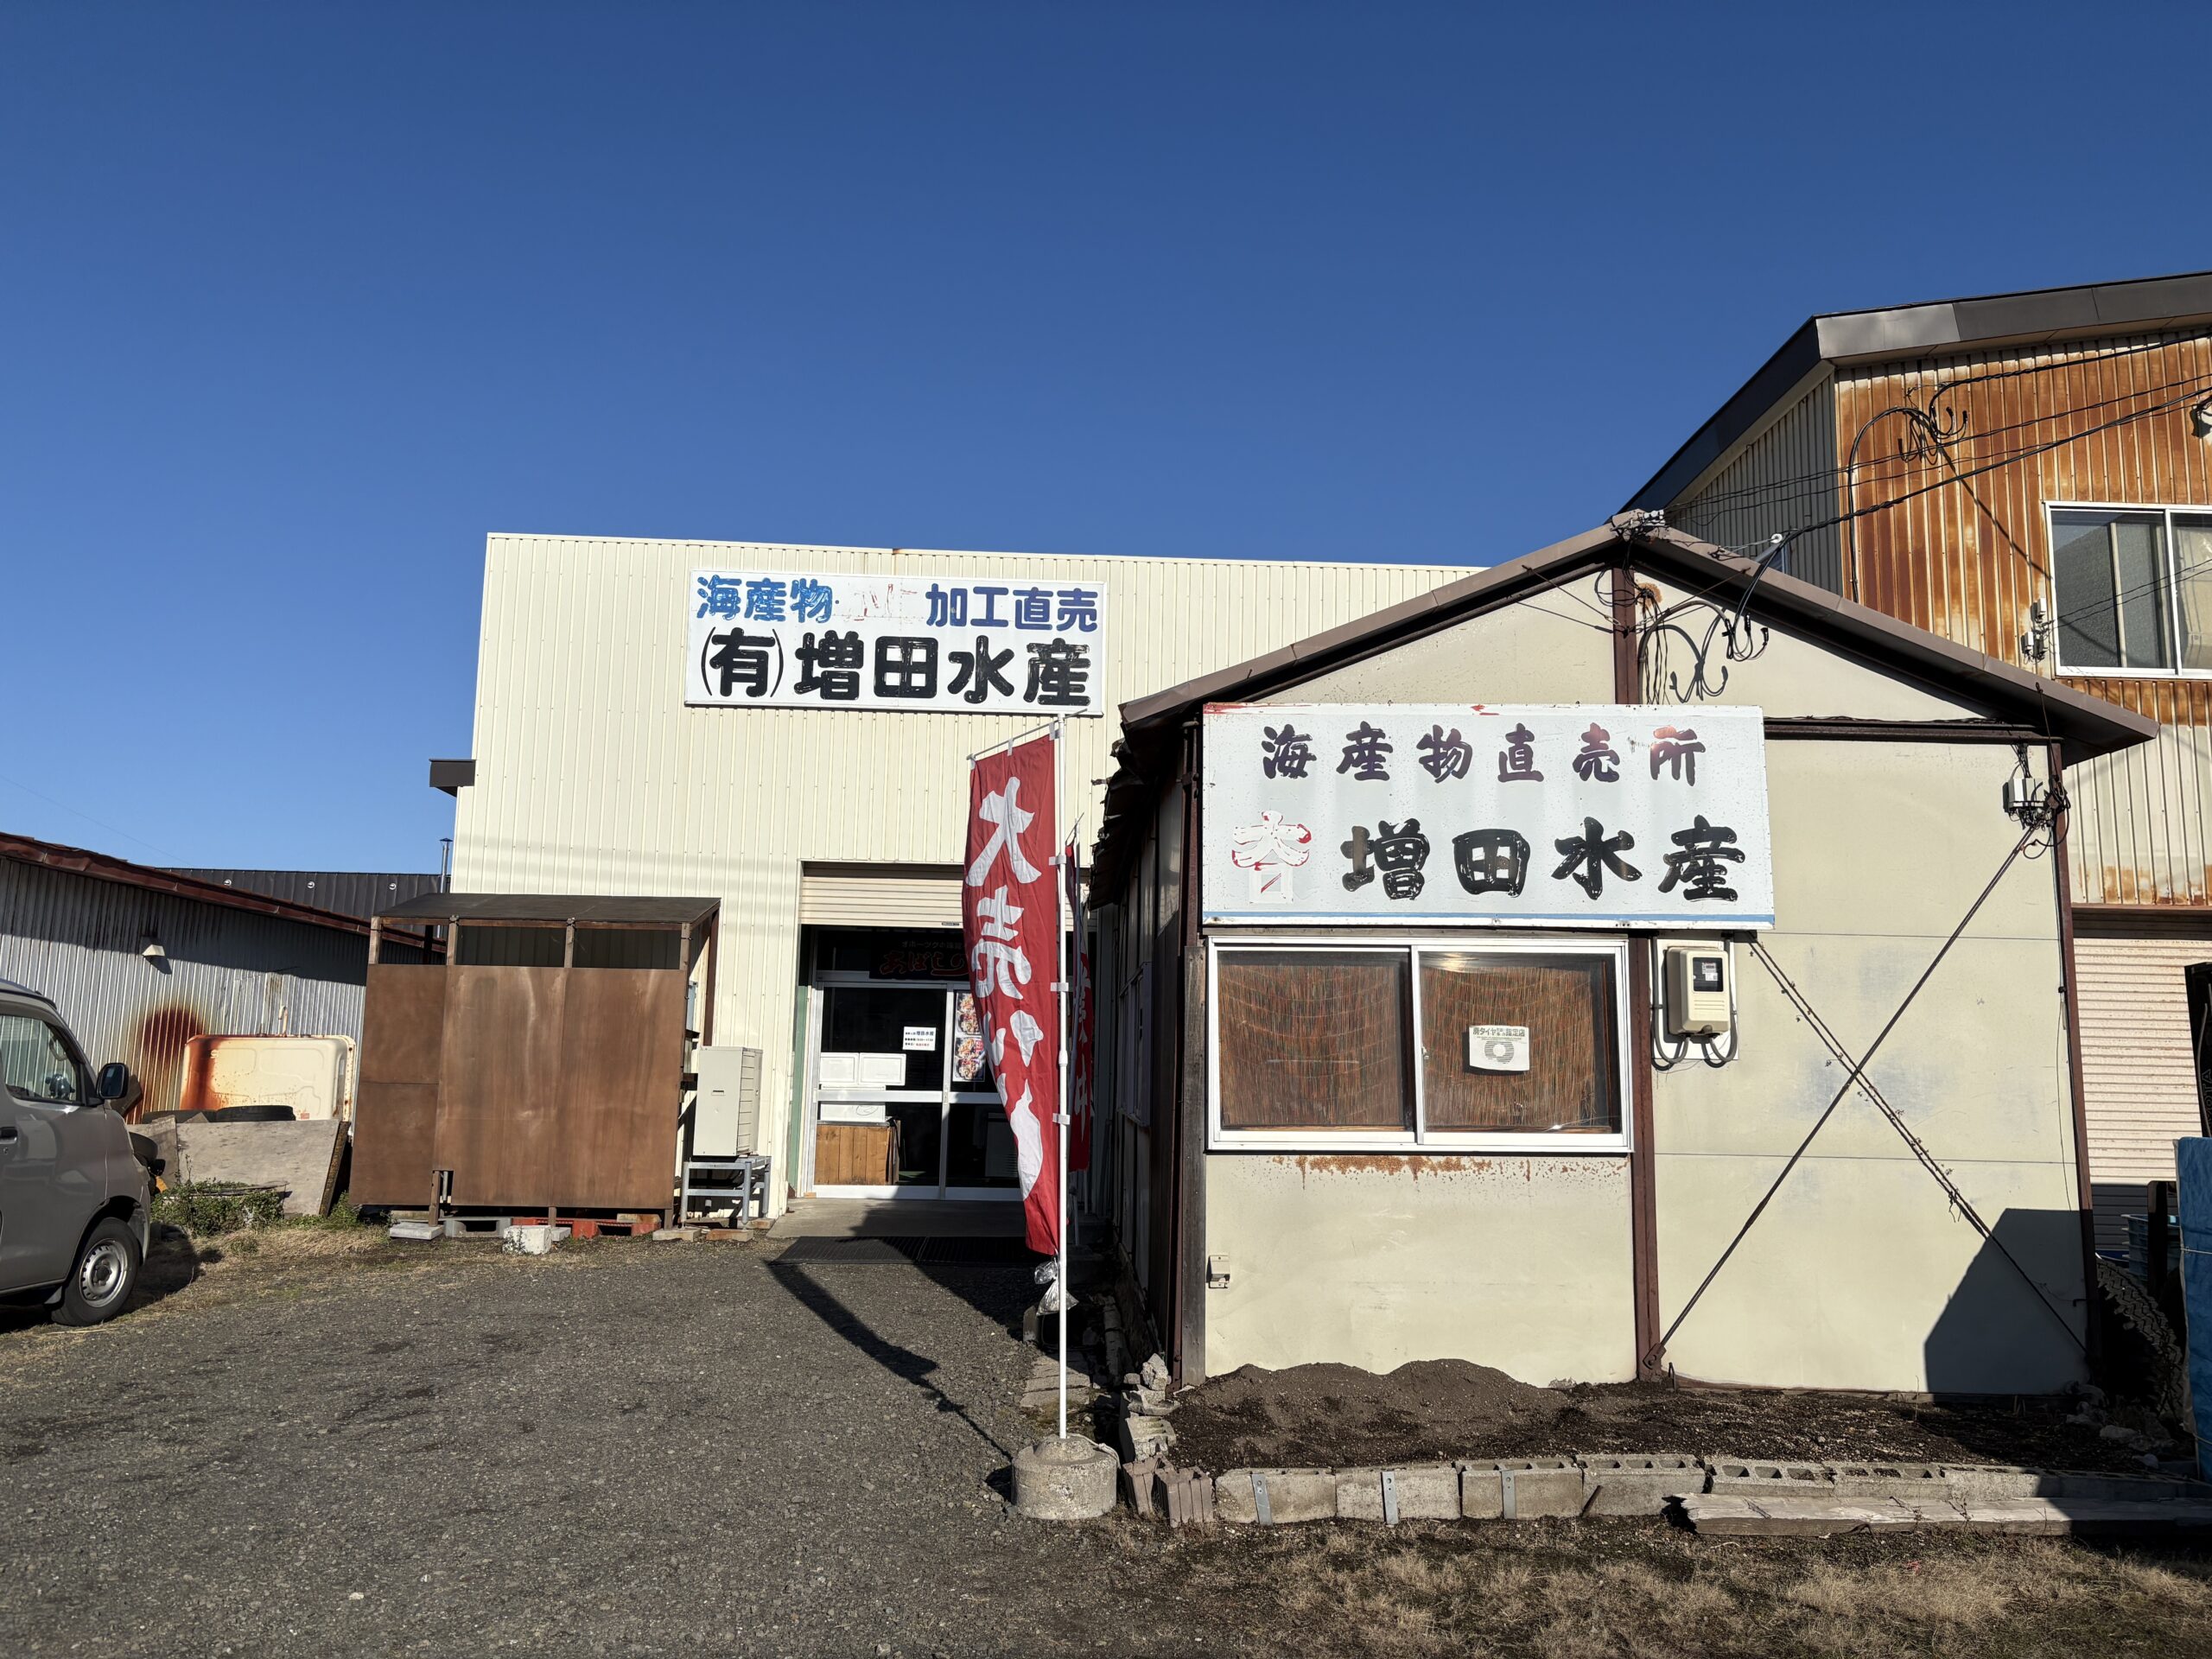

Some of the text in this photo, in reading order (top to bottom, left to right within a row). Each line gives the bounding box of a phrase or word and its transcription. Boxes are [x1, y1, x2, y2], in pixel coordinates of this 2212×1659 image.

[696, 575, 834, 624] 海産物
[925, 583, 1098, 632] 加工直売
[701, 626, 1091, 706] (有)増田水産
[1261, 721, 1707, 786] 海産物直売所
[1340, 814, 1745, 902] 増田水産
